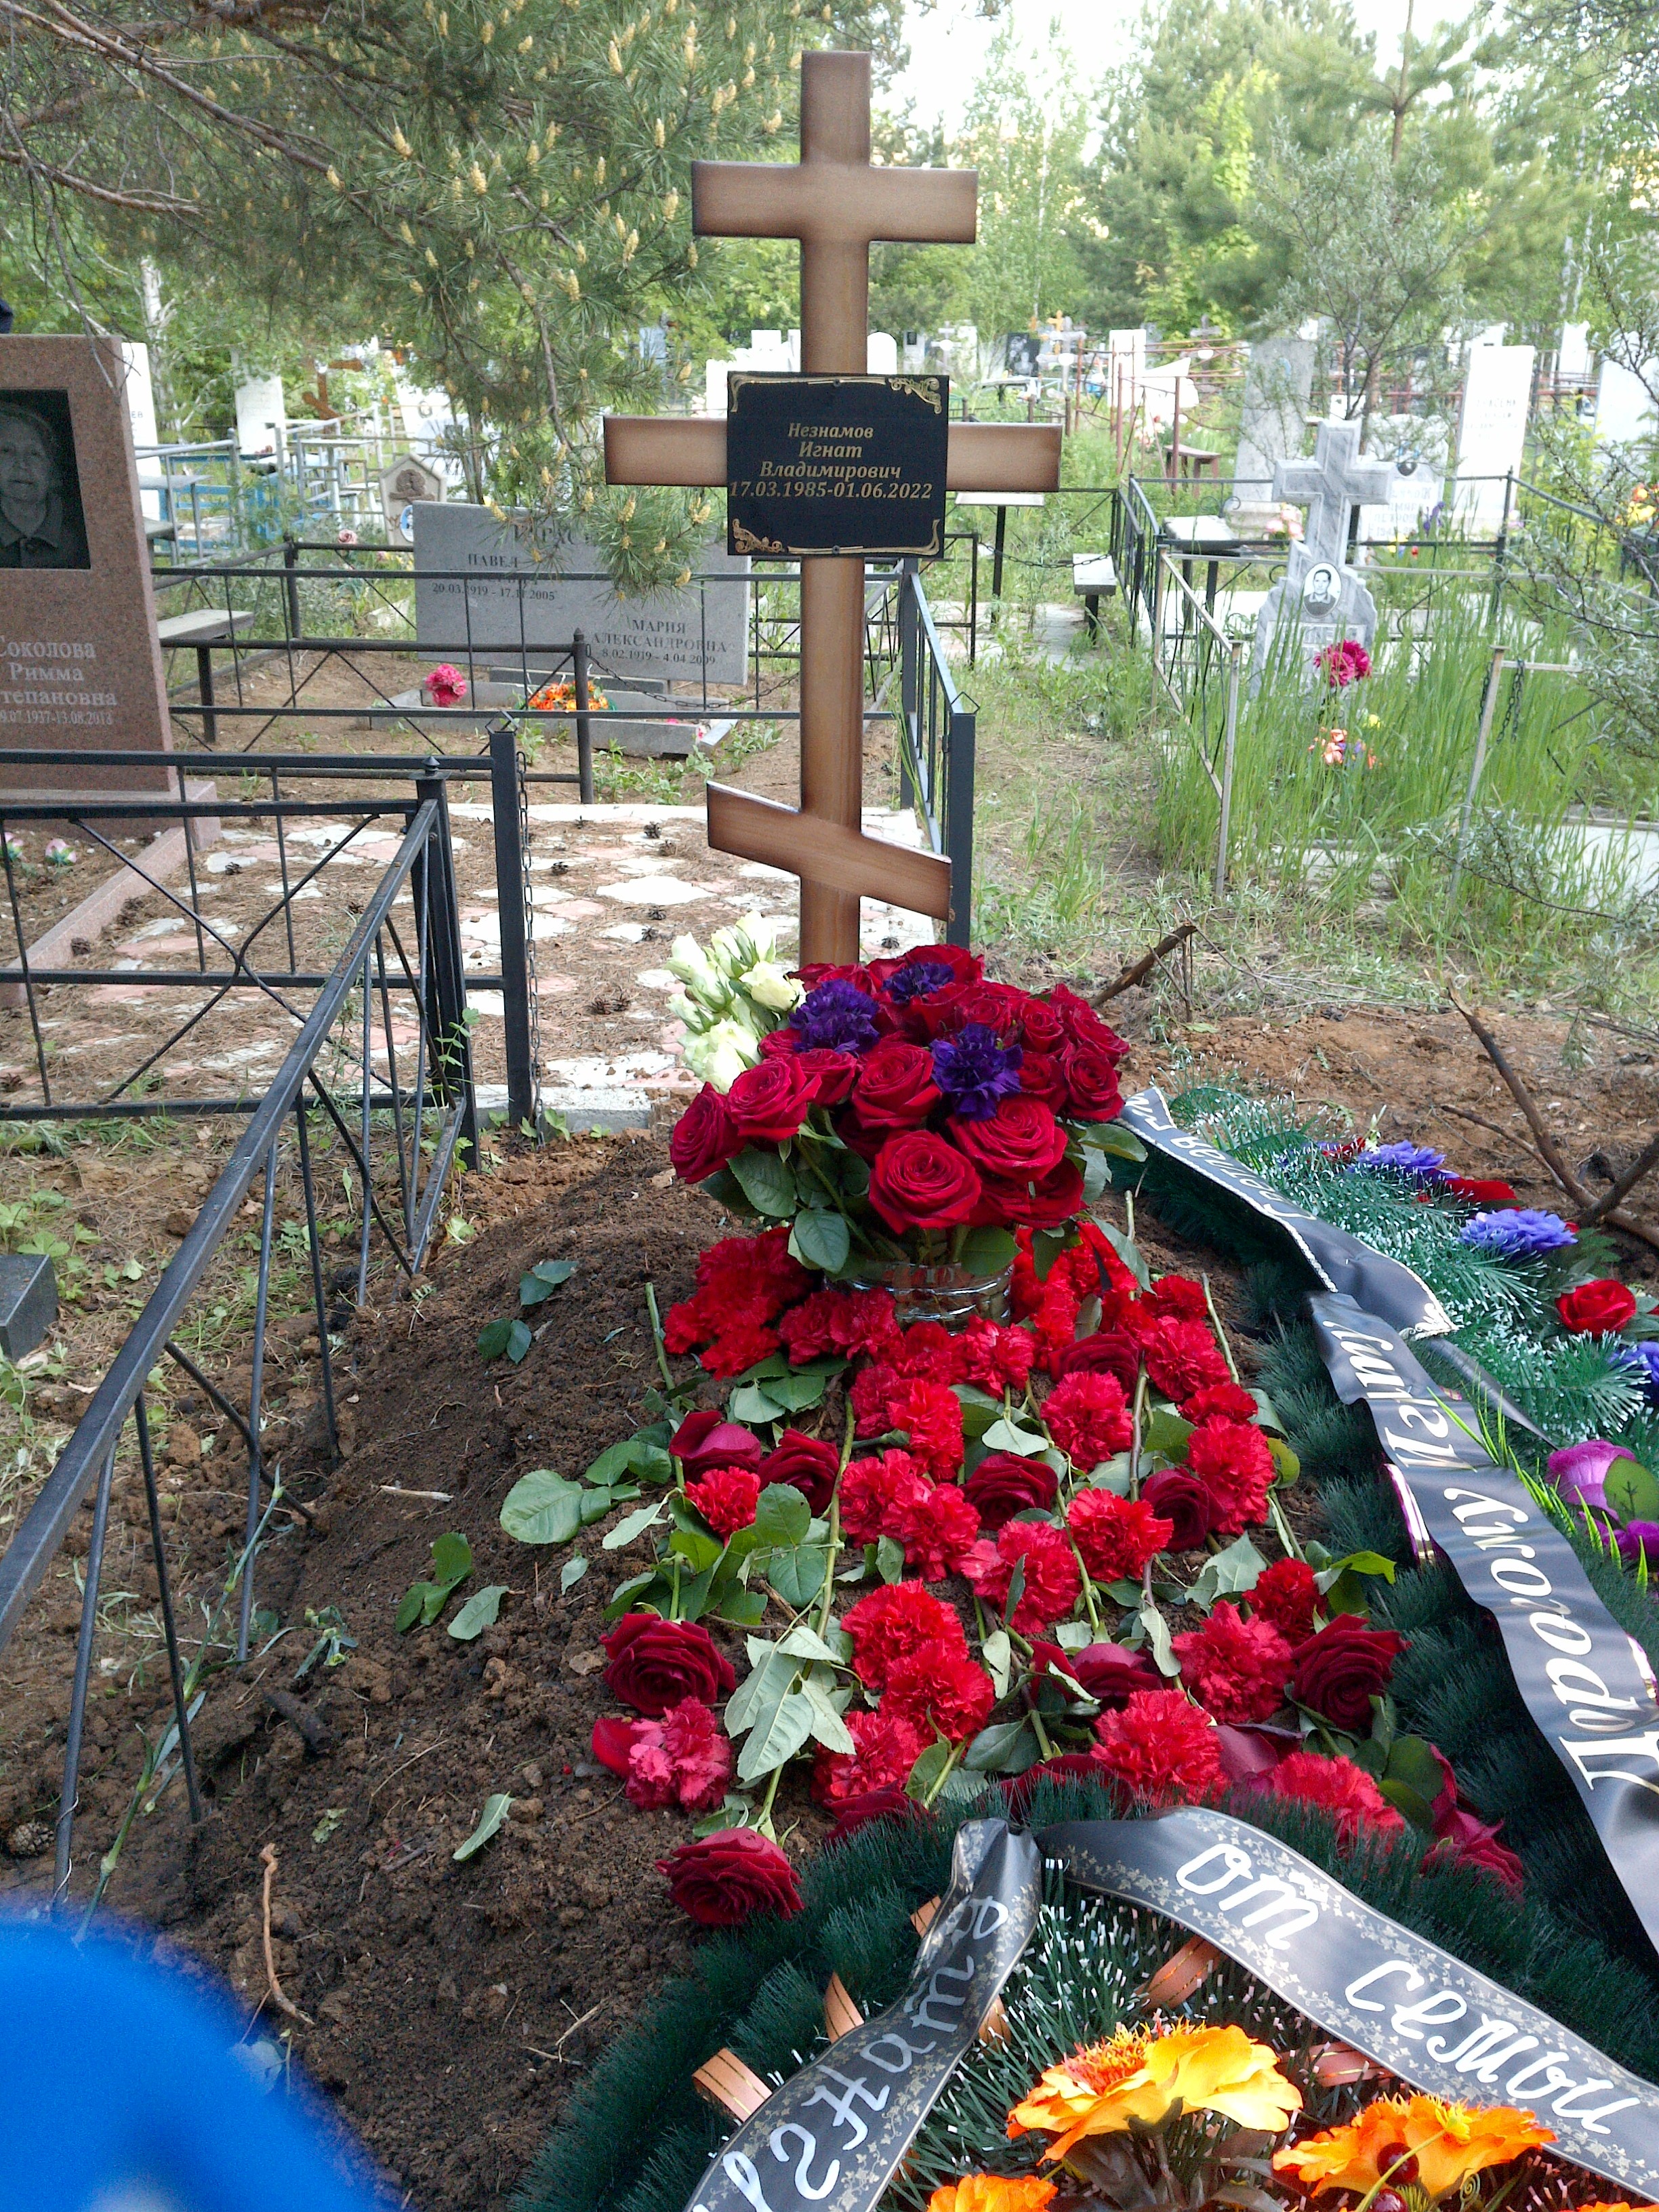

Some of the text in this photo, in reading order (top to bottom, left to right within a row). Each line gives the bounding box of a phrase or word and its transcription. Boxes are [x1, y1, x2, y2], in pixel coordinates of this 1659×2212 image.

[787, 422, 874, 438] Незнамов
[798, 442, 863, 458] Игнат
[759, 461, 902, 480] Владимирович
[729, 481, 933, 499] 17.03.1985-01.06.2022
[468, 553, 518, 568] ПАВЕЛ
[632, 619, 687, 634] МАРИЯ
[592, 634, 727, 653] АЛЕКСАНДРОВНА
[8, 662, 84, 681] Римма
[0, 690, 118, 705] тепановна
